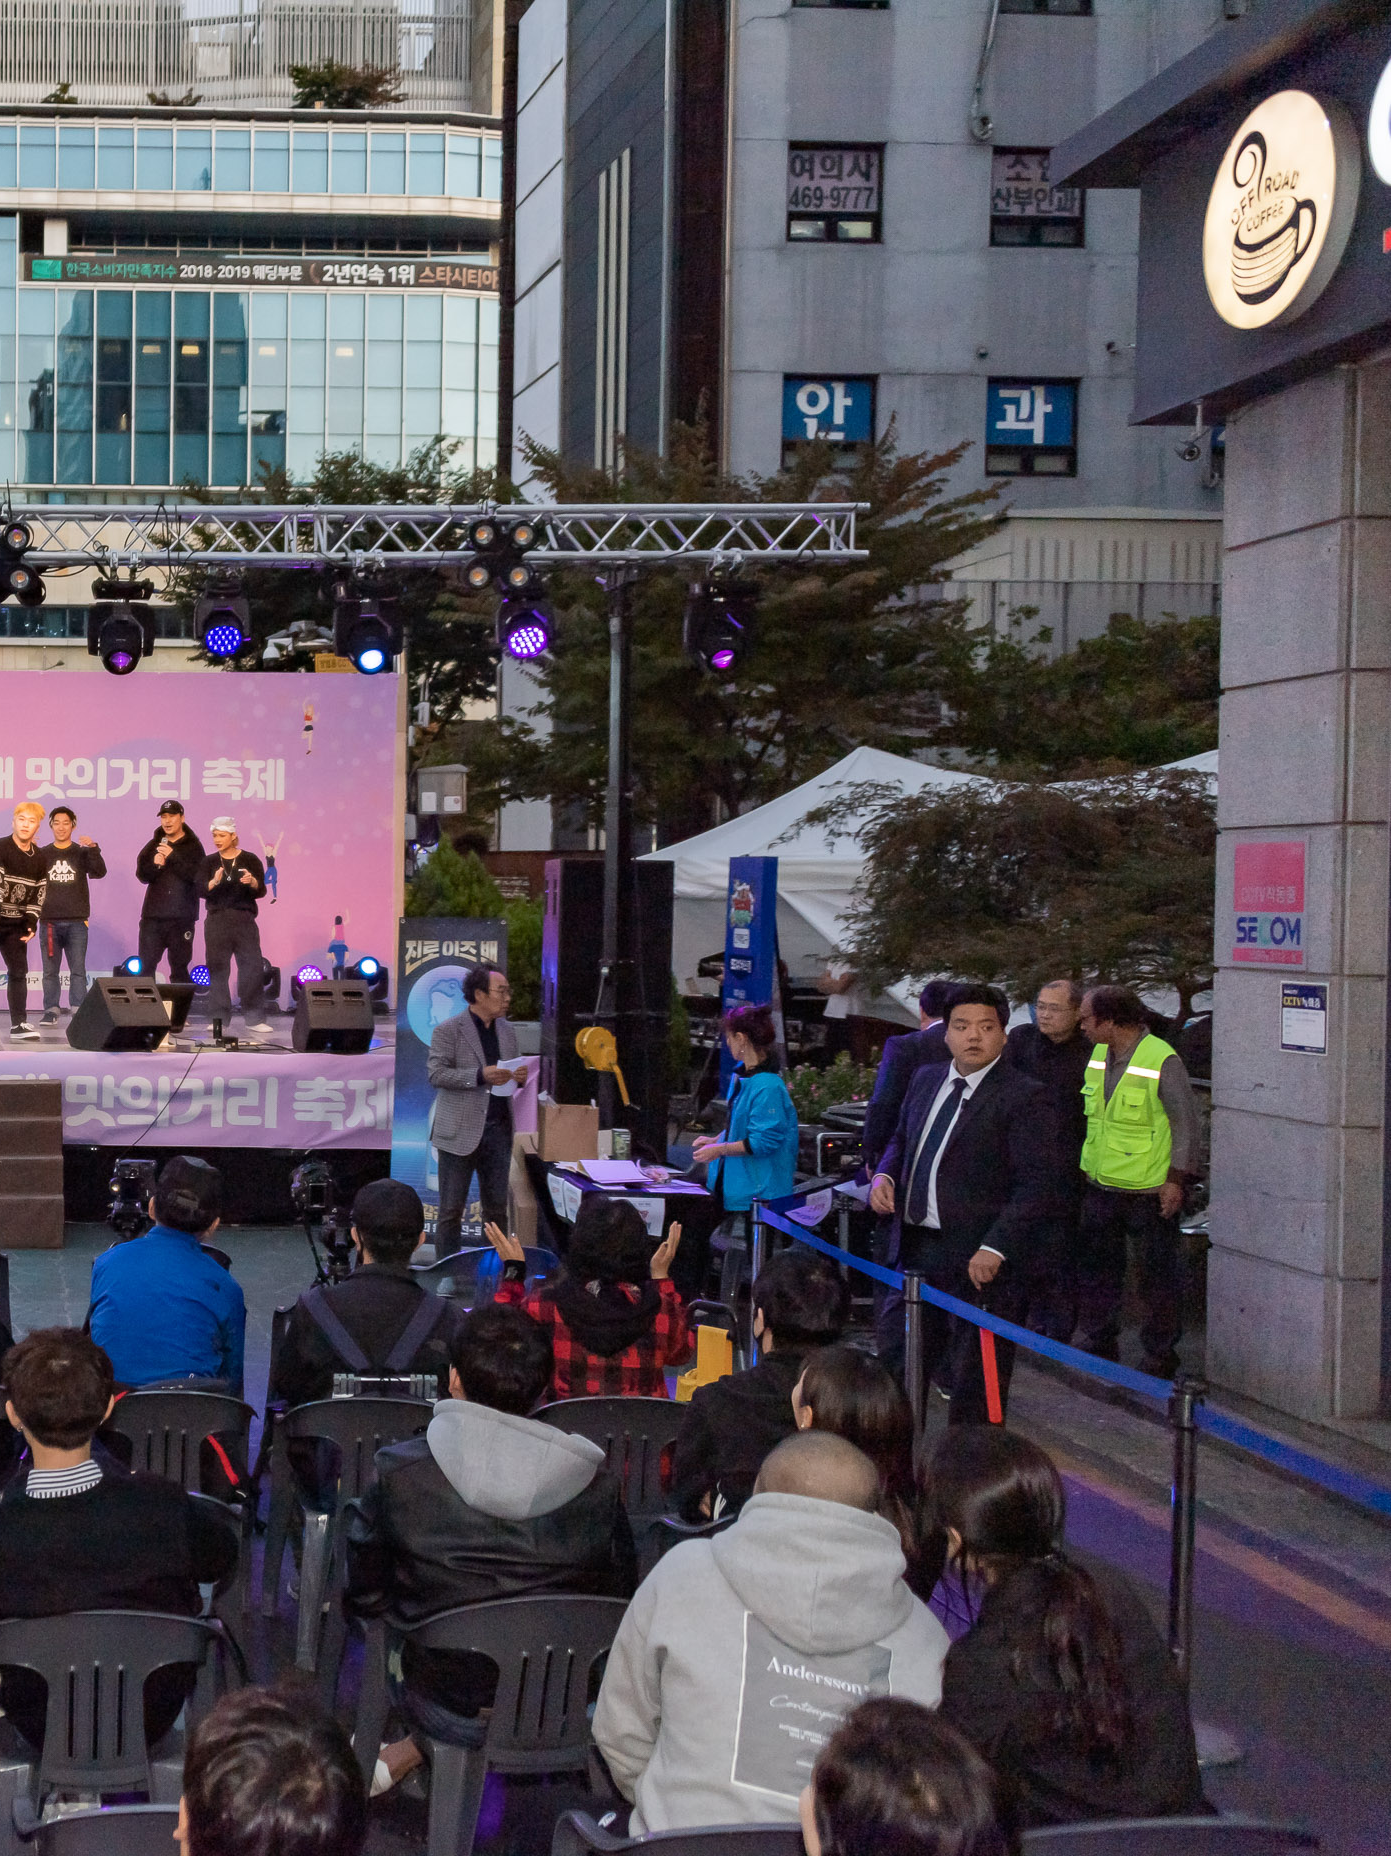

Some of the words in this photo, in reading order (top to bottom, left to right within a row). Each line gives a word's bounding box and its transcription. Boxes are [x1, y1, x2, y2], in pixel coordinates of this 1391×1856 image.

[790, 153, 875, 182] 여의사
[322, 264, 385, 285] 2년연속
[388, 265, 416, 285] 1위
[795, 382, 852, 440] 안
[995, 384, 1053, 444] 과
[25, 757, 191, 800] 맛의거리
[201, 757, 286, 801] 축제
[49, 873, 75, 883] Kappa
[1236, 916, 1302, 946] SECOM
[65, 1074, 279, 1129] 맛의거리
